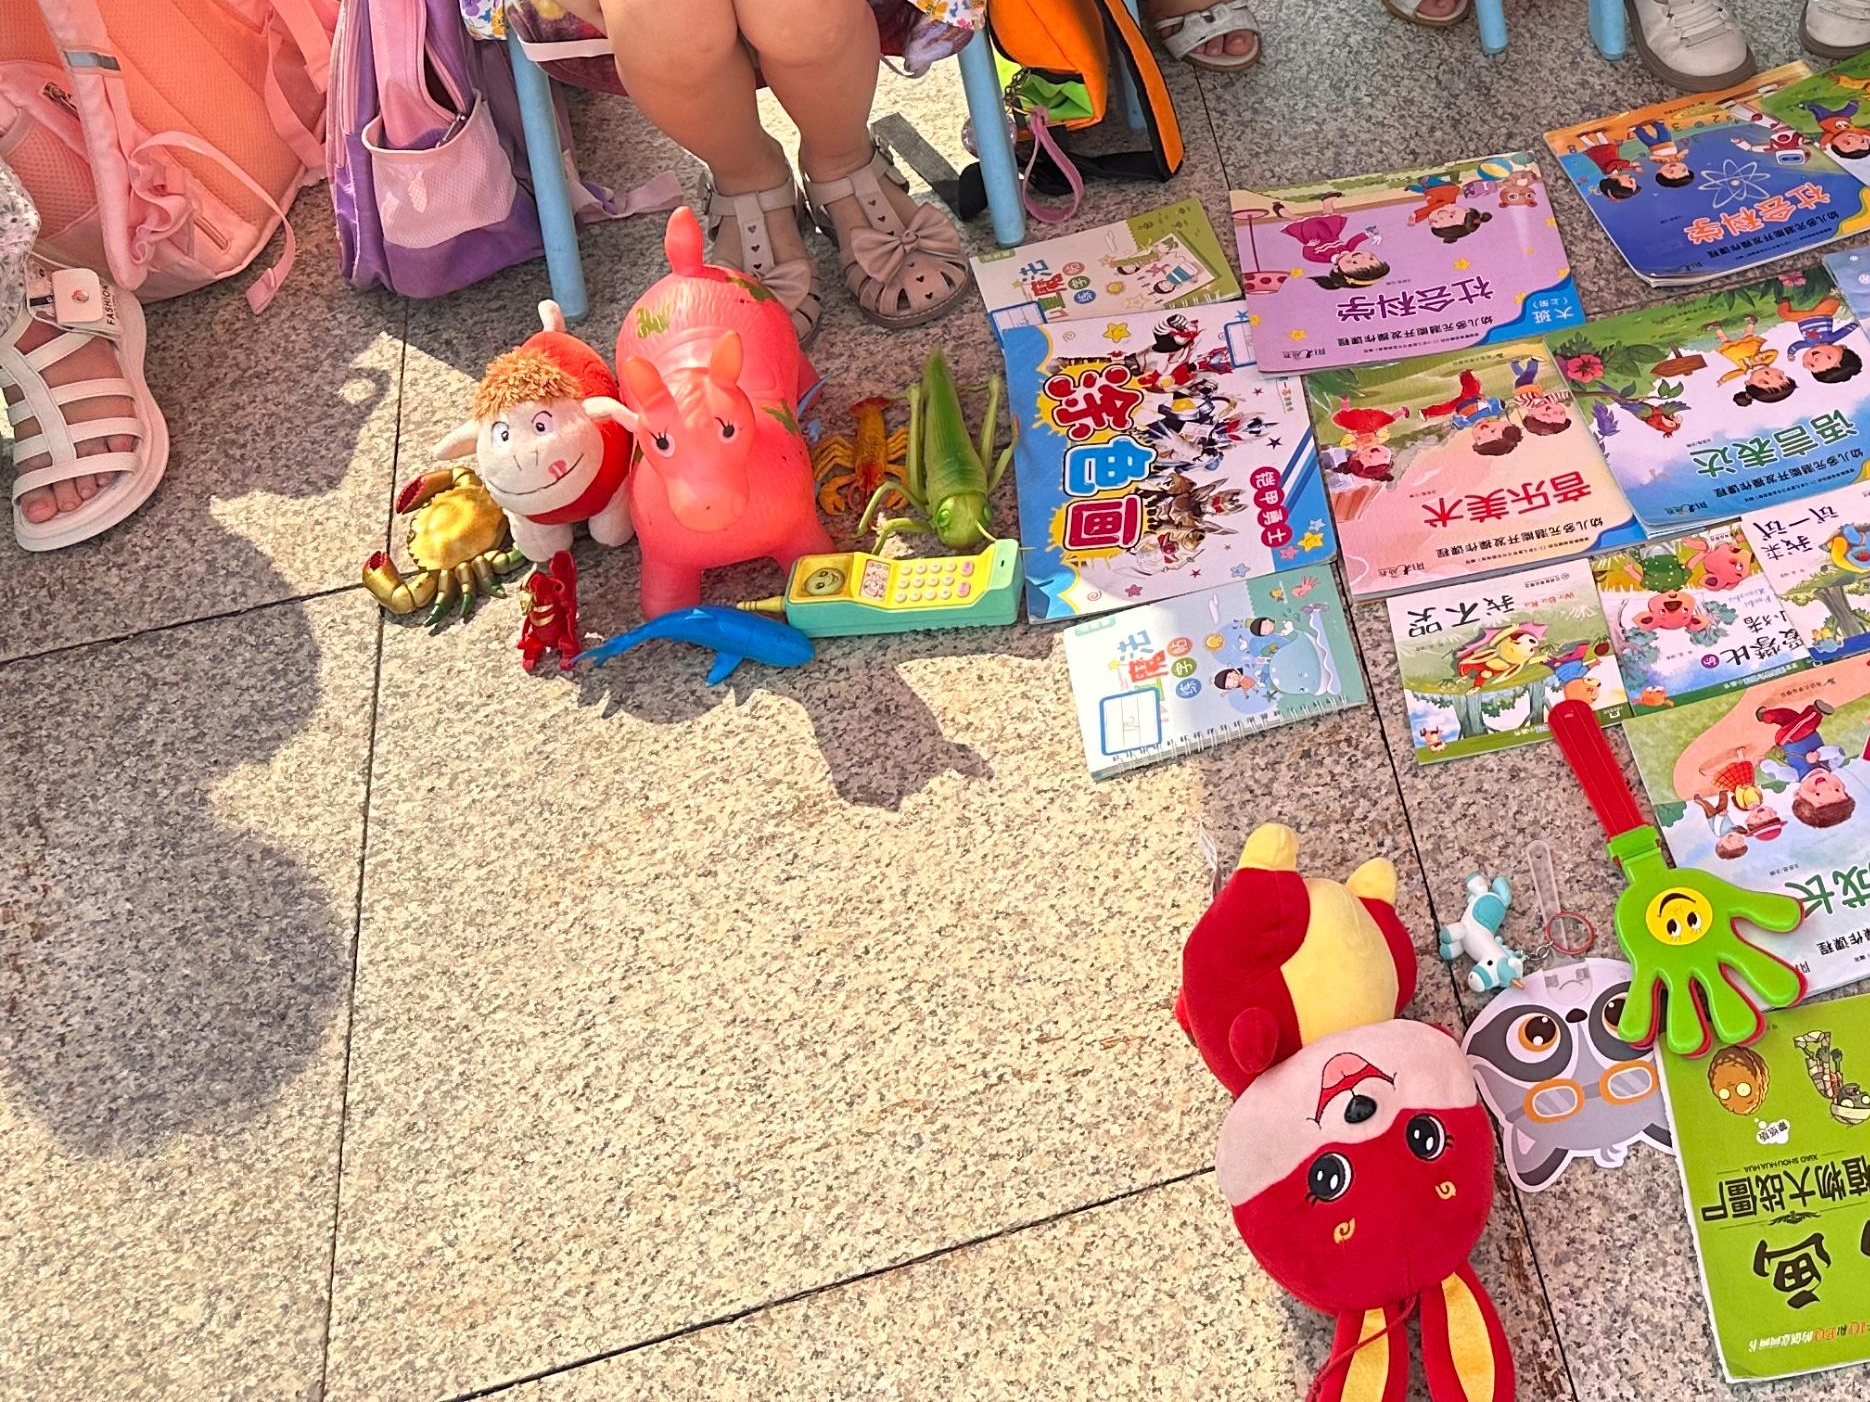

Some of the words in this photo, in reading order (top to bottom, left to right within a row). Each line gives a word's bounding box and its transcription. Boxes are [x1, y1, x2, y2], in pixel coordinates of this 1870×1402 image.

[1683, 182, 1830, 245] 社会科学
[1337, 275, 1494, 323] 社会科学
[1532, 305, 1575, 324] 大班
[1337, 316, 1494, 347] 幼儿多元潜能开发操作课程
[1045, 365, 1156, 549] 涂色画
[1690, 410, 1858, 477] 语言表达
[1255, 471, 1287, 544] 铠甲勇士
[1421, 471, 1591, 529] 音乐美术
[1436, 517, 1603, 559] 幼儿多元潜能开发操作课程
[1752, 504, 1839, 542] 试一试
[1759, 535, 1813, 561] 我来
[1407, 595, 1515, 638] 我不哭
